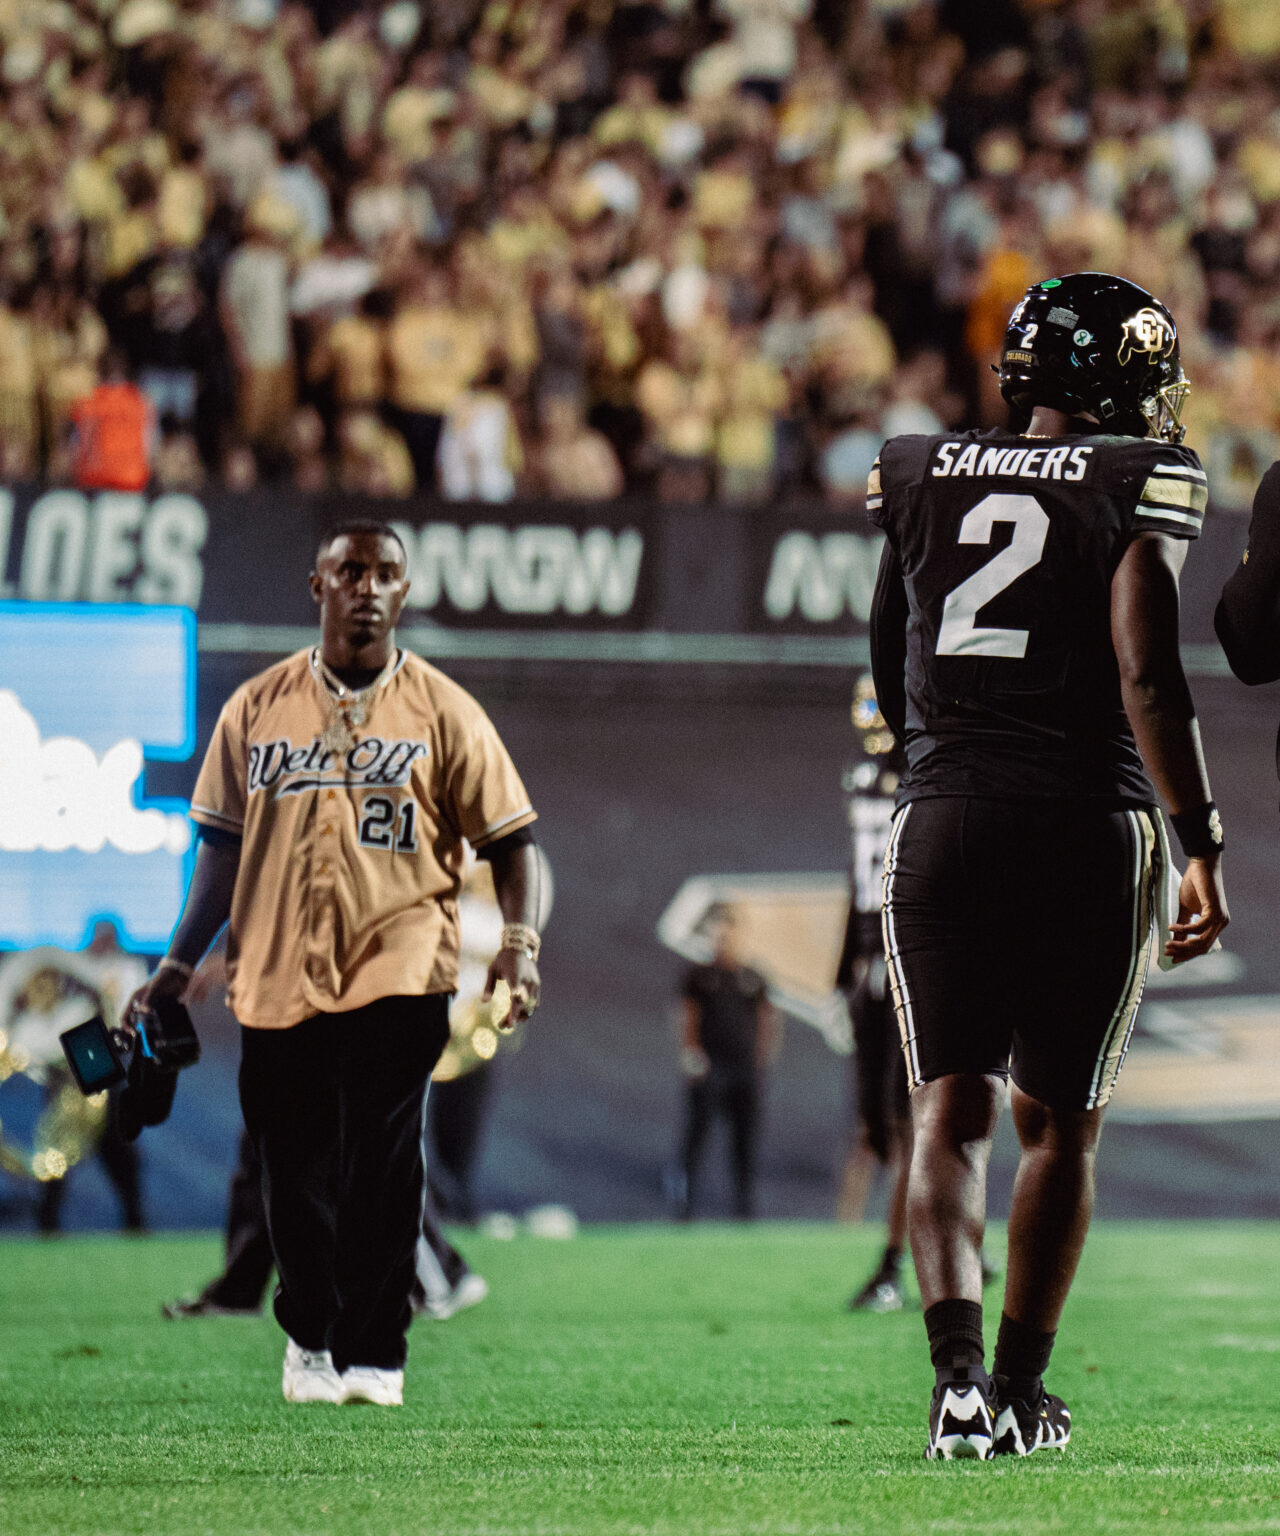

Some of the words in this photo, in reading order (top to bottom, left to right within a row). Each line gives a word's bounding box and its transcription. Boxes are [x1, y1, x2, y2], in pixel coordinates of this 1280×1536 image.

[1005, 351, 1033, 364] COLORADO
[1020, 323, 1039, 349] 2
[932, 442, 1093, 481] SANDERS
[935, 493, 1050, 658] 2
[346, 737, 428, 785] Off
[358, 795, 418, 853] 21
